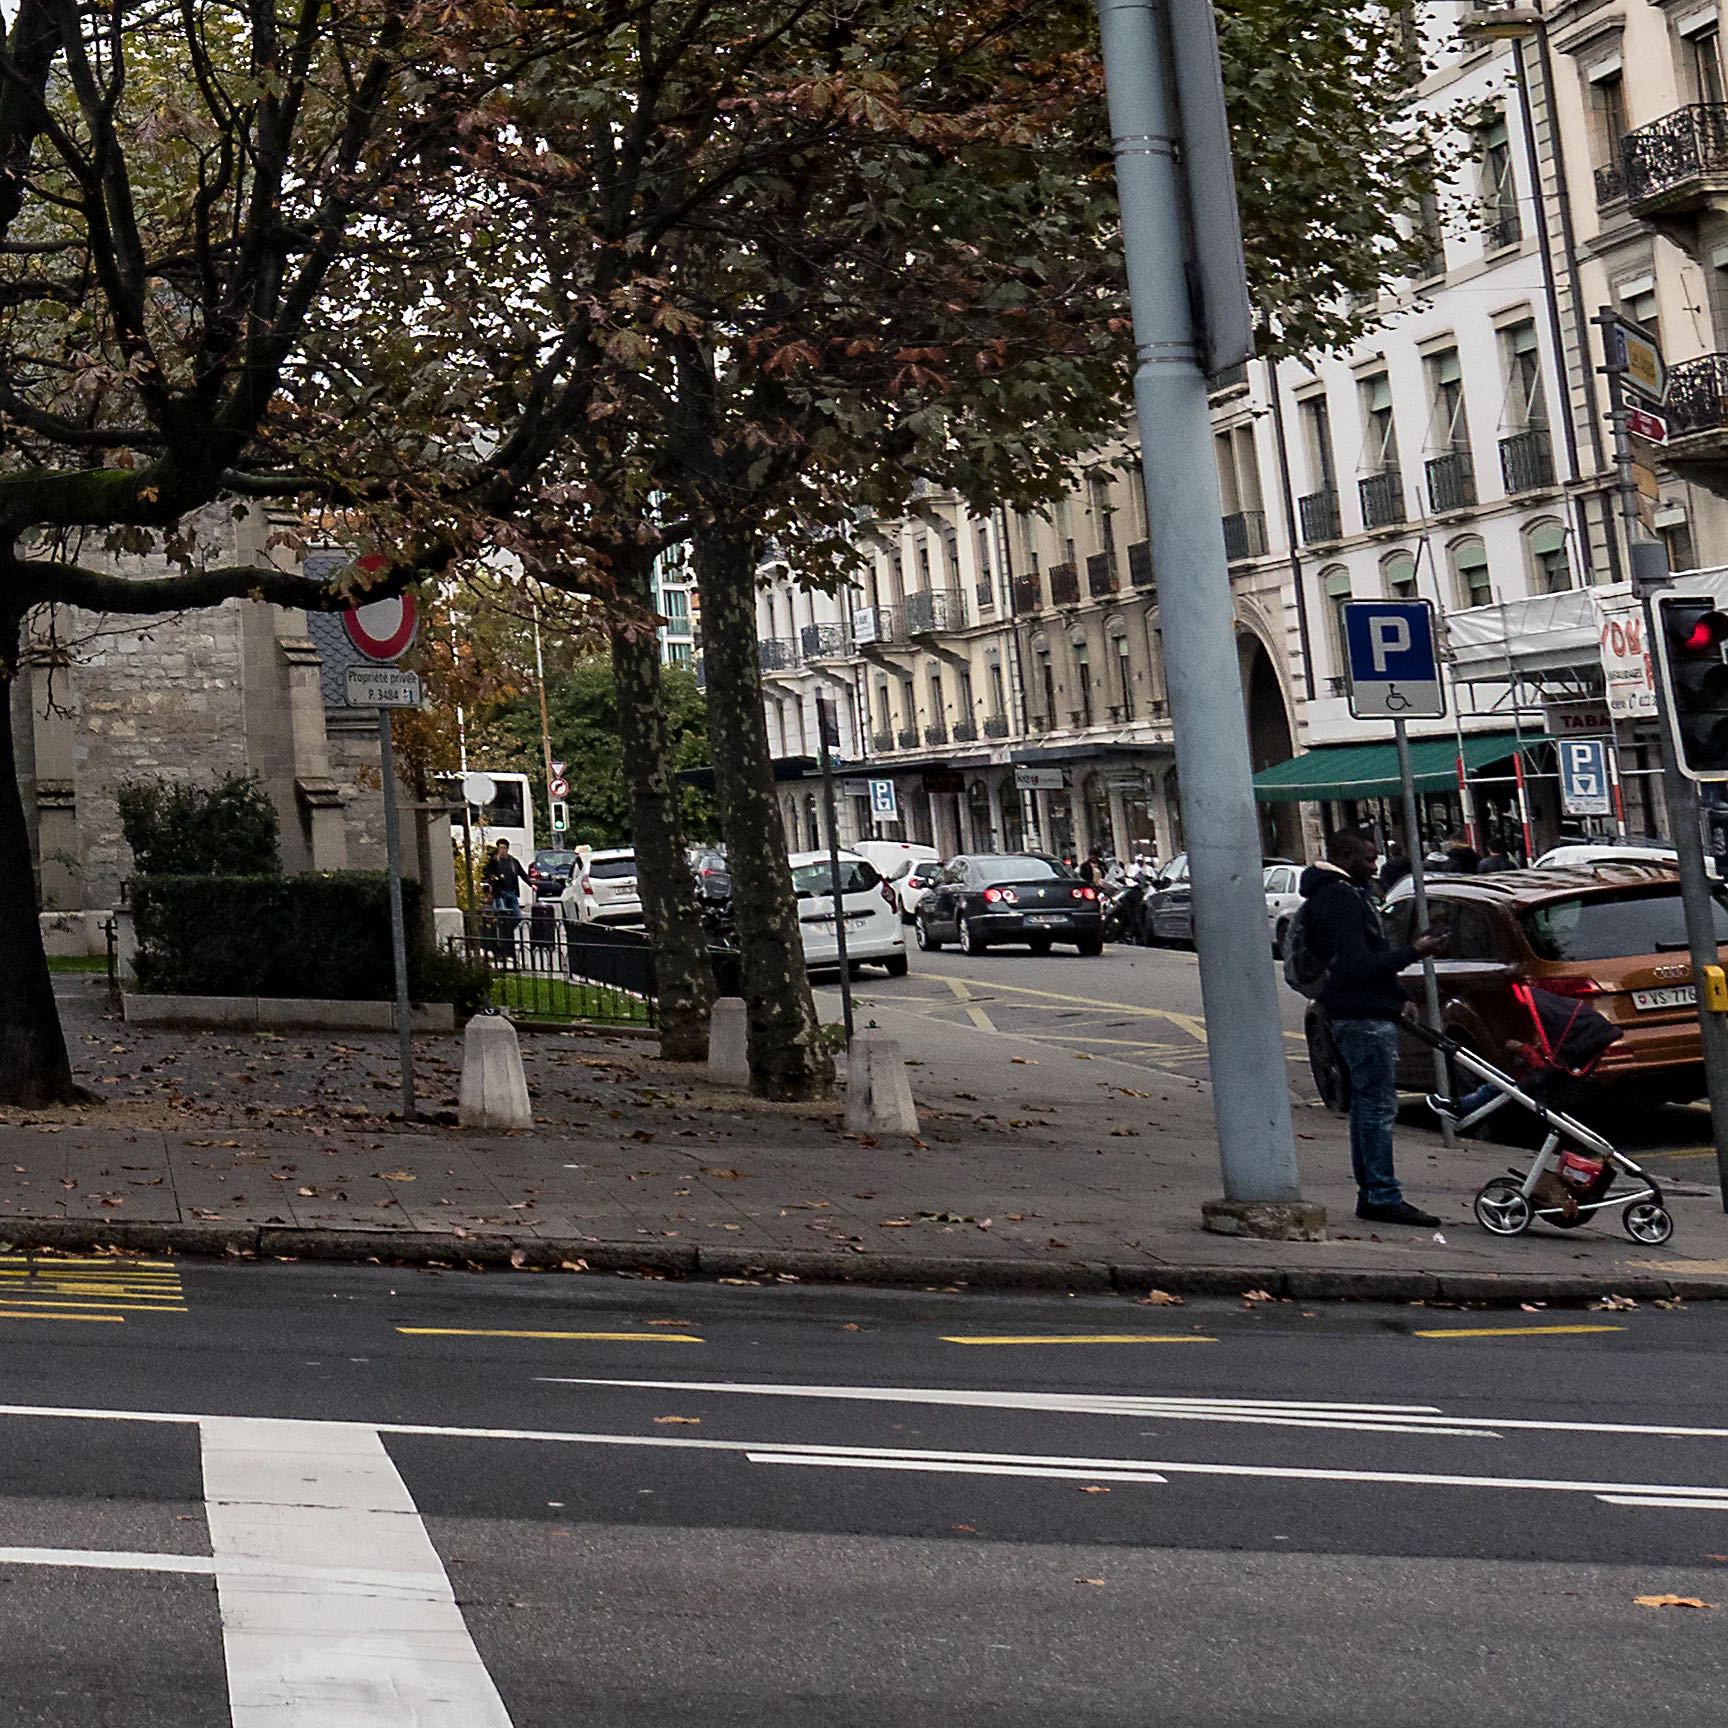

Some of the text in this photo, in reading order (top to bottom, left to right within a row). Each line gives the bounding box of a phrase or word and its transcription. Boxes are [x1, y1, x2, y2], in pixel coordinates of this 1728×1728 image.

[1369, 616, 1411, 672] P
[348, 671, 417, 685] Propriété privée
[1571, 744, 1592, 773] P
[876, 783, 888, 798] P
[1649, 988, 1697, 1005] VS 776
